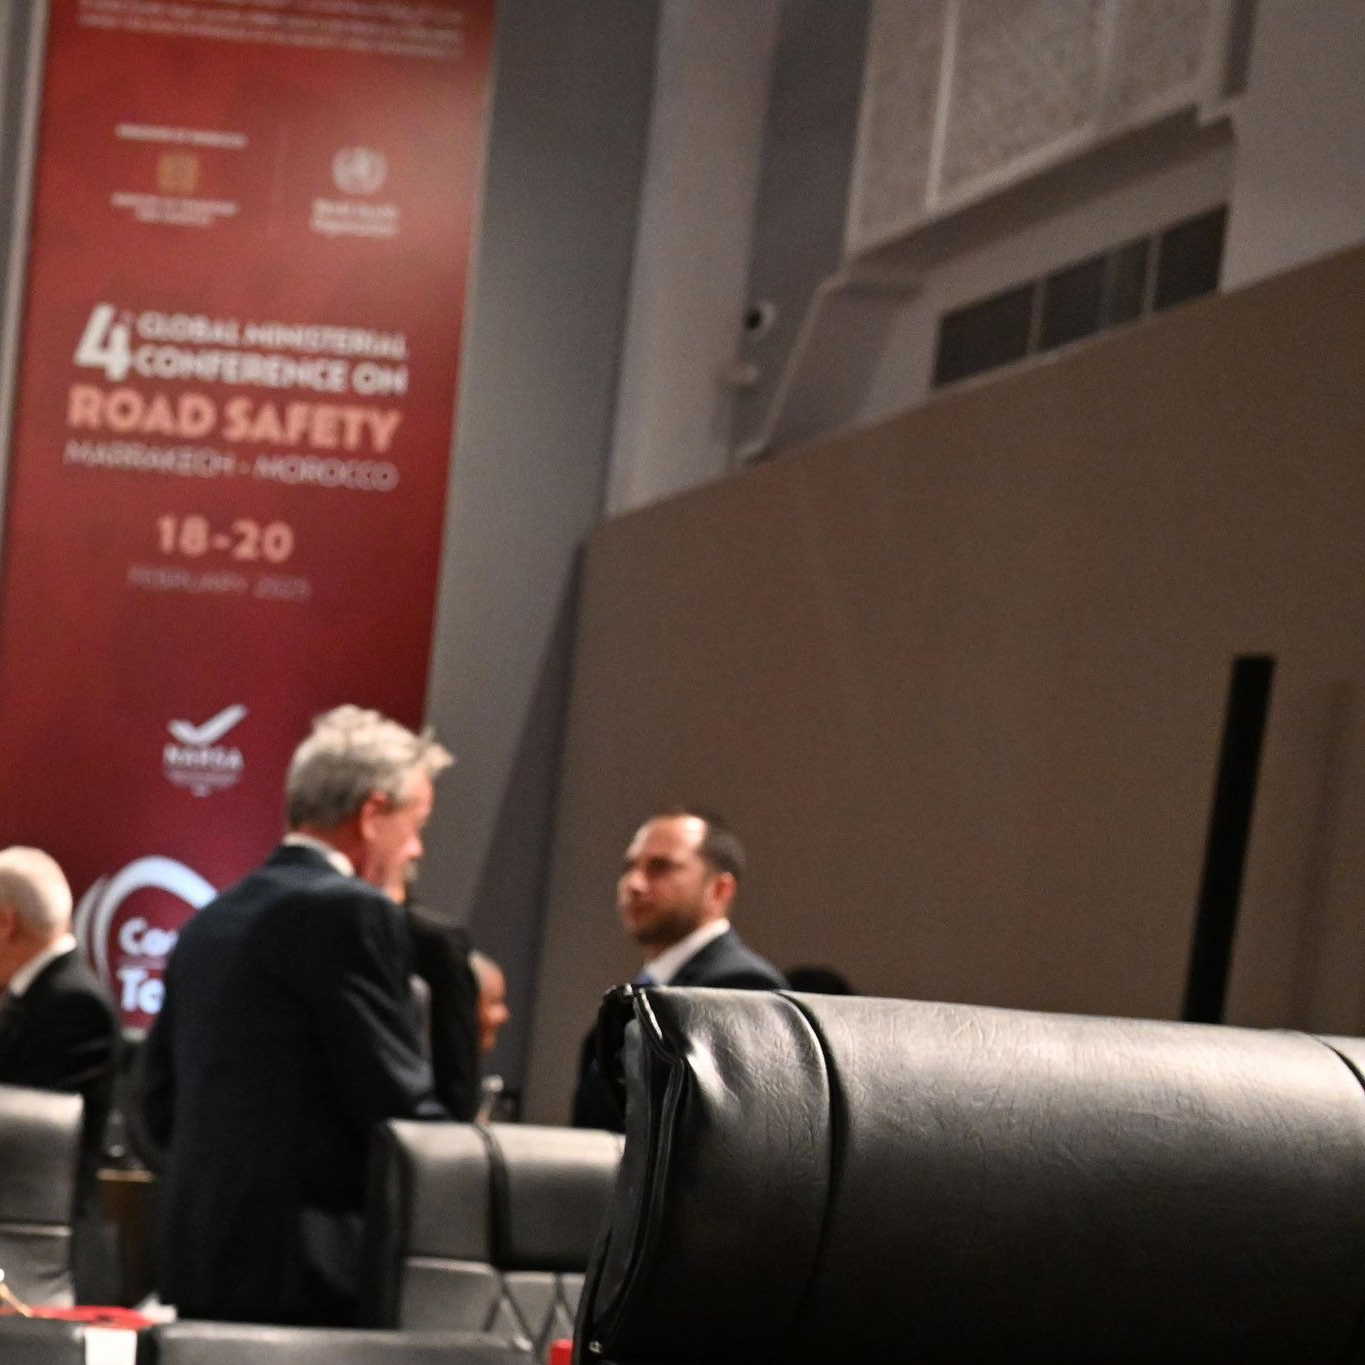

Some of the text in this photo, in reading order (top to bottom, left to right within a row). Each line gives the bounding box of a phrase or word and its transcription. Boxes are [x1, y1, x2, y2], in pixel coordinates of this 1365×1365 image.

[137, 311, 238, 346] GLOBAL
[244, 321, 407, 359] MINISTERIAL
[134, 345, 407, 394] CONFERENCE ON
[68, 385, 401, 451] ROAD SAFETY
[253, 455, 399, 491] MOROCCO
[158, 514, 293, 562] 18-20
